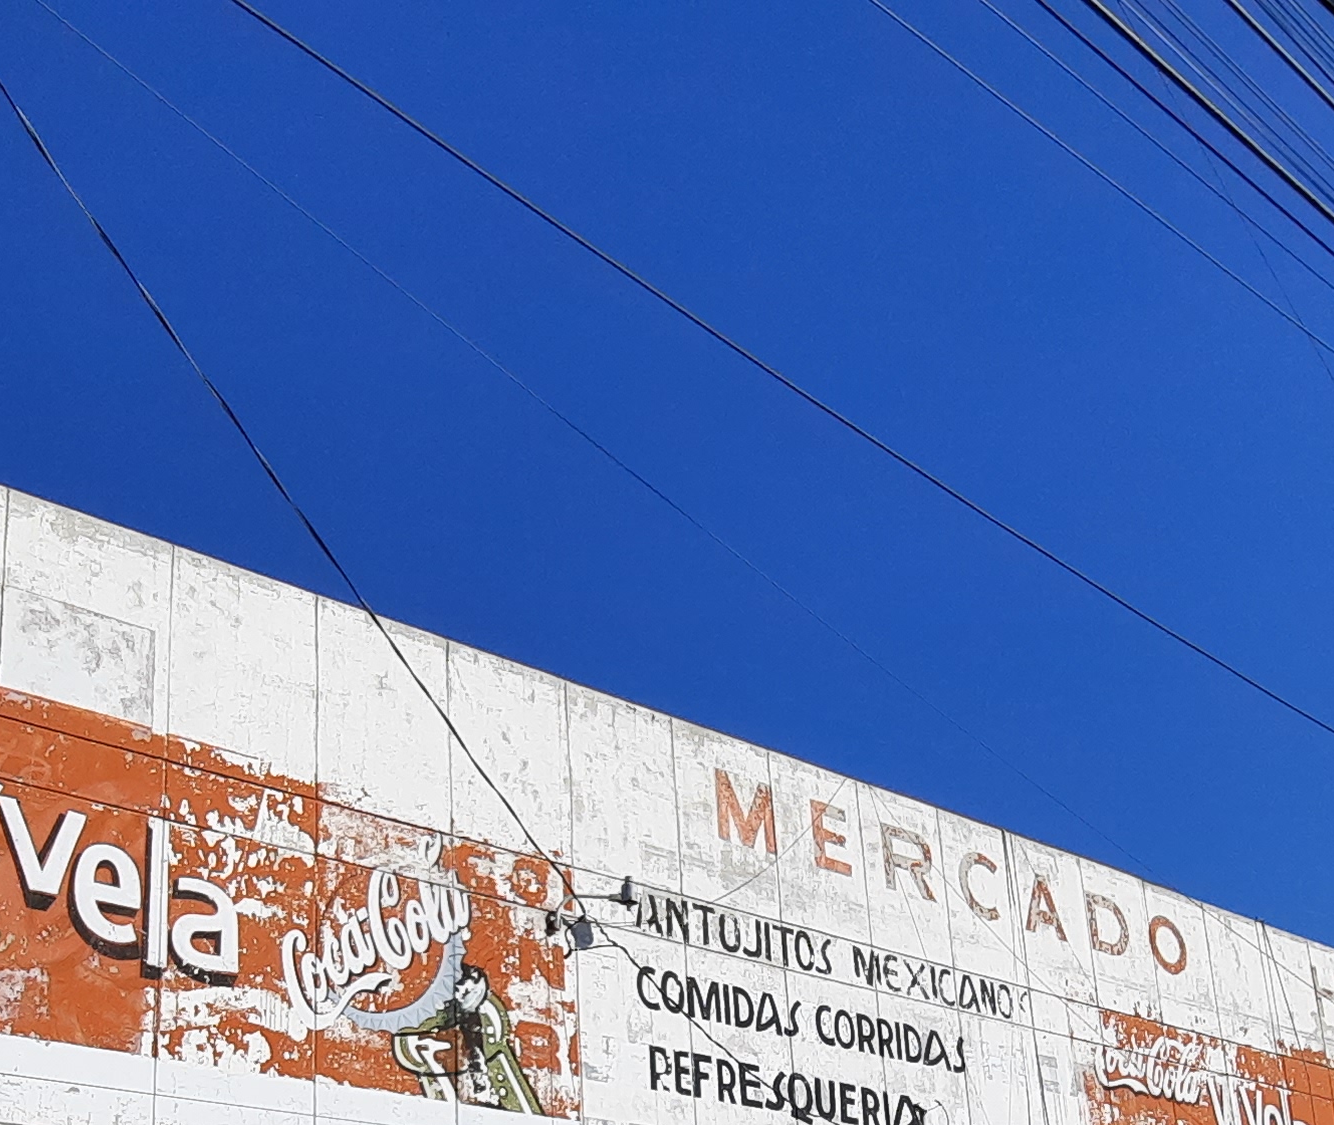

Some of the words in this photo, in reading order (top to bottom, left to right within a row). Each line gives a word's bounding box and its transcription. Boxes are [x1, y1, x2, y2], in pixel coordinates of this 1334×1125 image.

[713, 768, 1188, 976] MERCADO
[635, 893, 833, 976] ANTOJITOS
[635, 965, 802, 1037] COMIDAS
[815, 1004, 966, 1073] CORRIDAS
